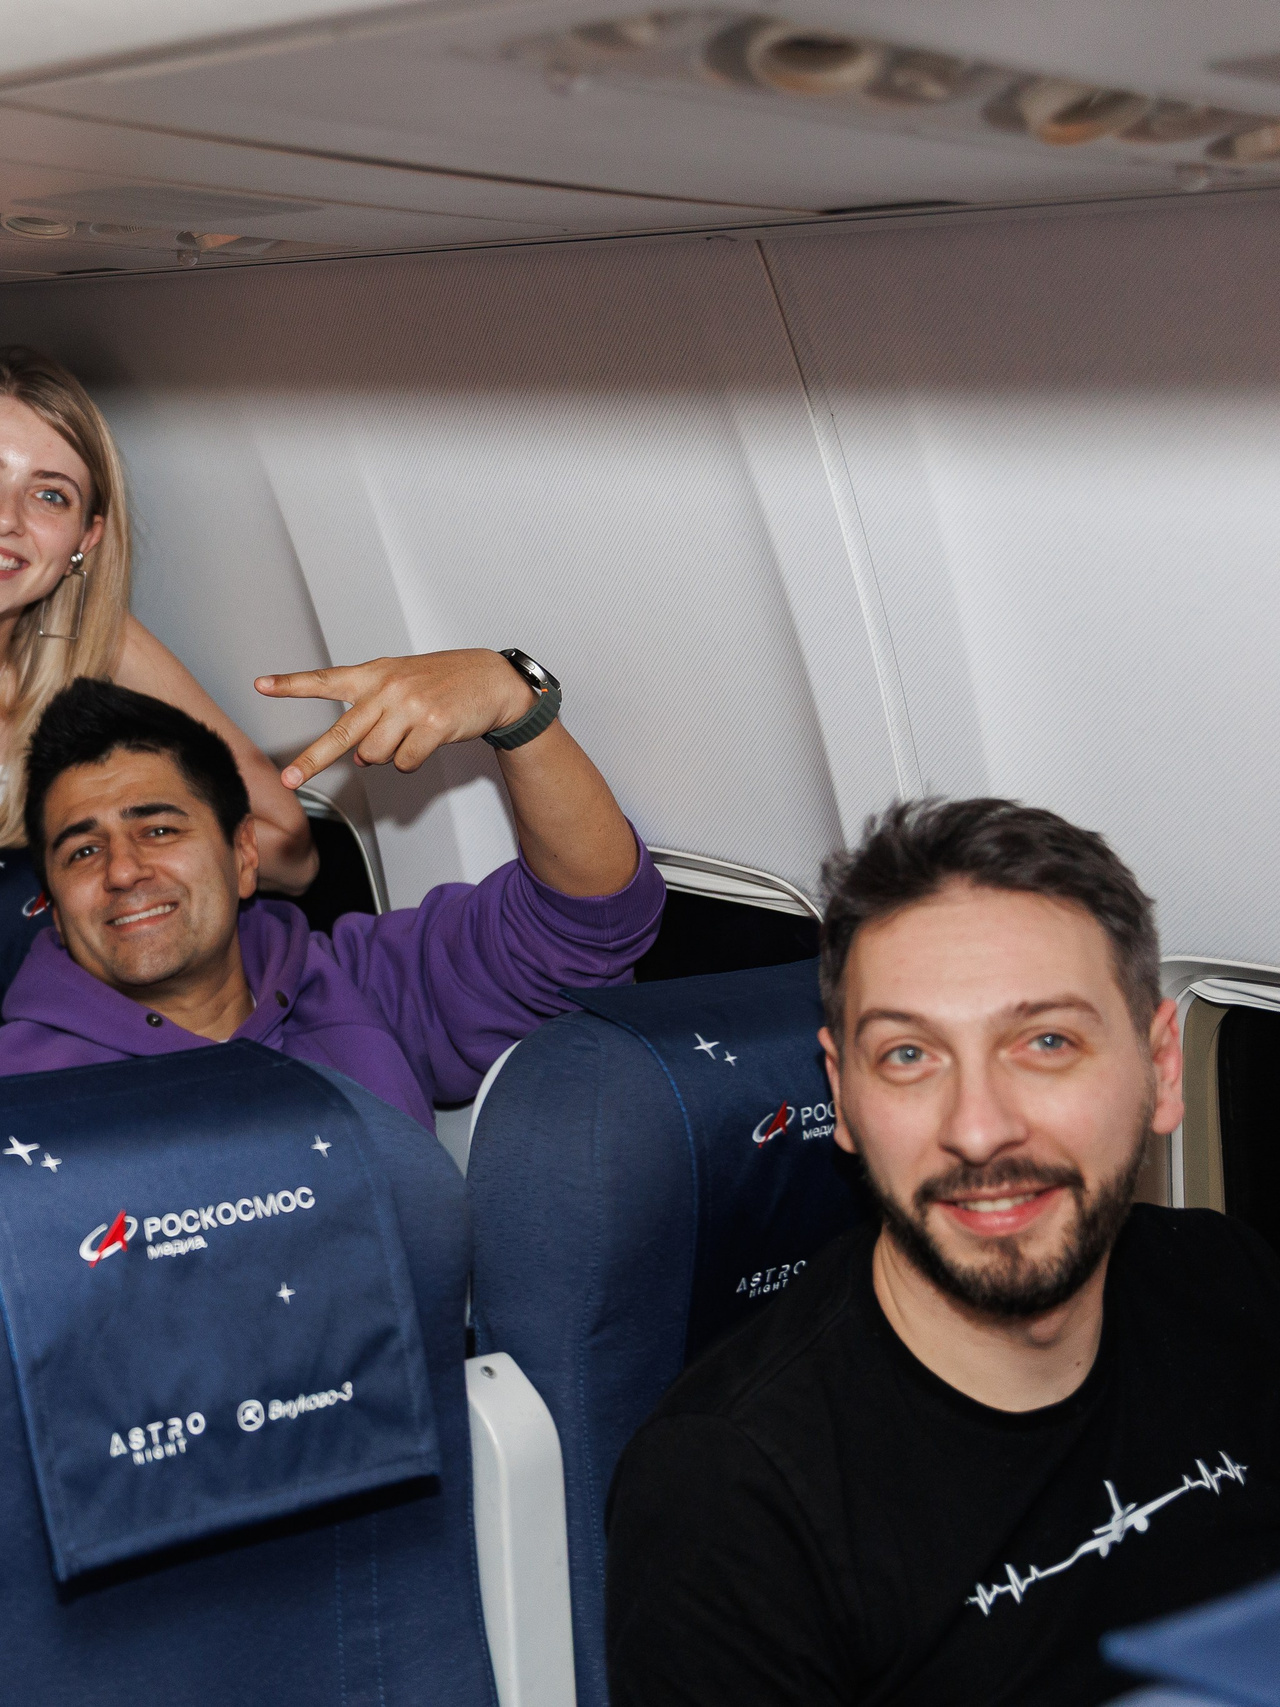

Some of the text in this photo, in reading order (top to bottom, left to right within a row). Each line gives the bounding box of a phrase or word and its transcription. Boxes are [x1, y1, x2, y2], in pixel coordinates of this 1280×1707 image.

[143, 1185, 316, 1242] РОСКОСМОС
[146, 1235, 208, 1260] медиа
[749, 1278, 789, 1298] NIGHT
[268, 1381, 354, 1420] Внуково-3
[109, 1411, 206, 1458] ASTRO
[132, 1437, 187, 1465] NIGHT
